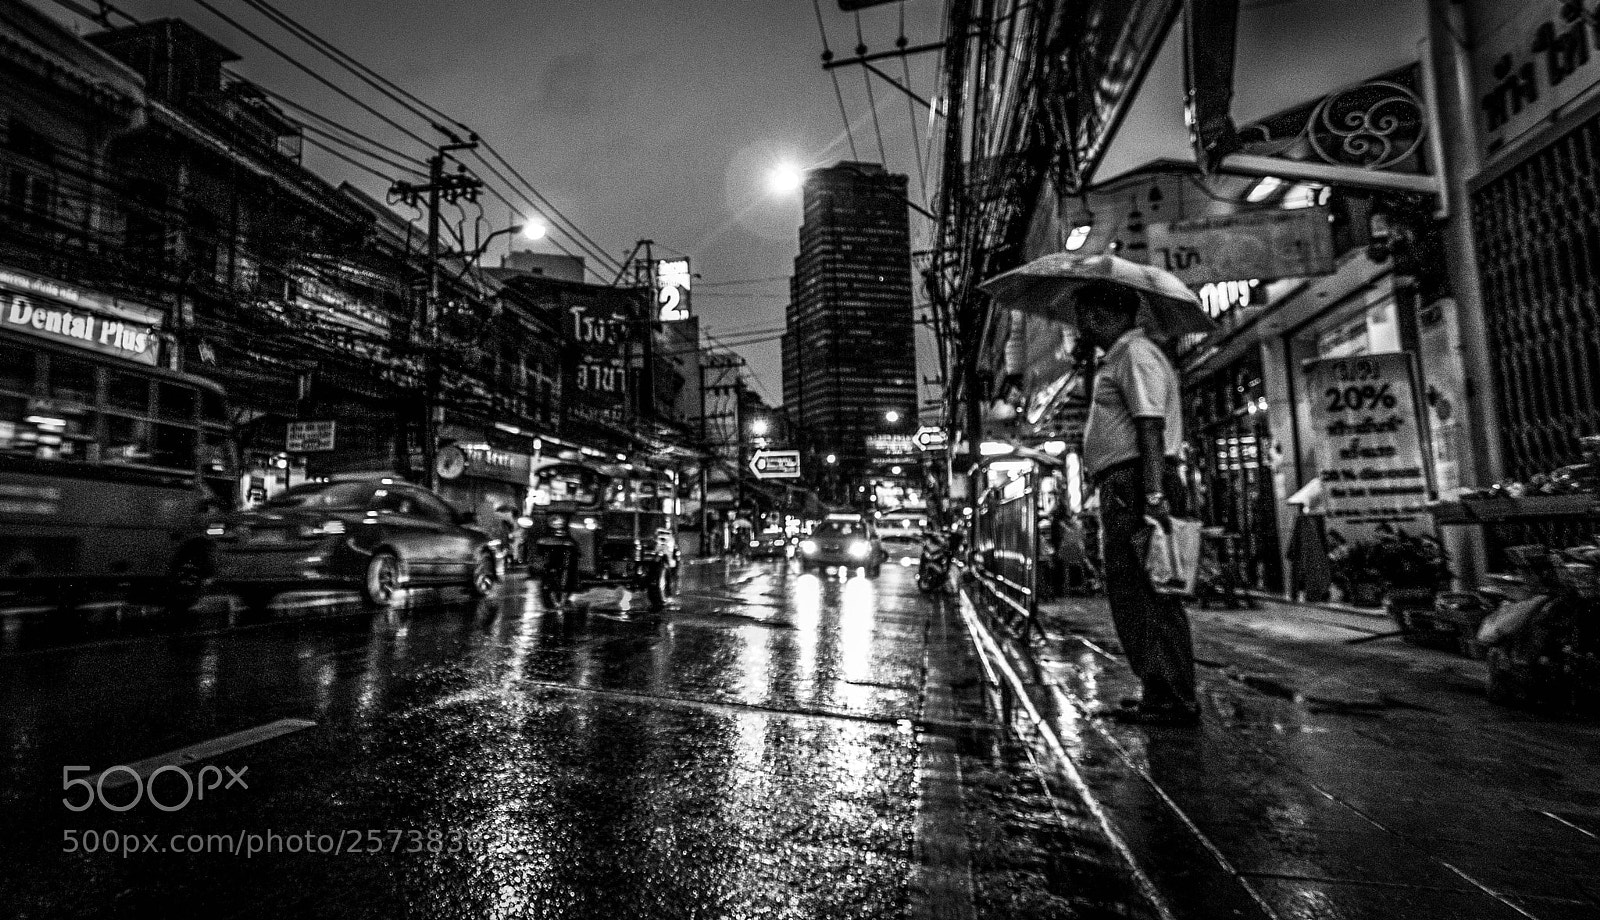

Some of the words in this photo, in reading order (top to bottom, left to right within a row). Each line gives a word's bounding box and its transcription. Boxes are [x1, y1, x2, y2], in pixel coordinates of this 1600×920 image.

[8, 298, 95, 341] Dental
[99, 320, 148, 354] Plus
[1325, 383, 1397, 412] 20%
